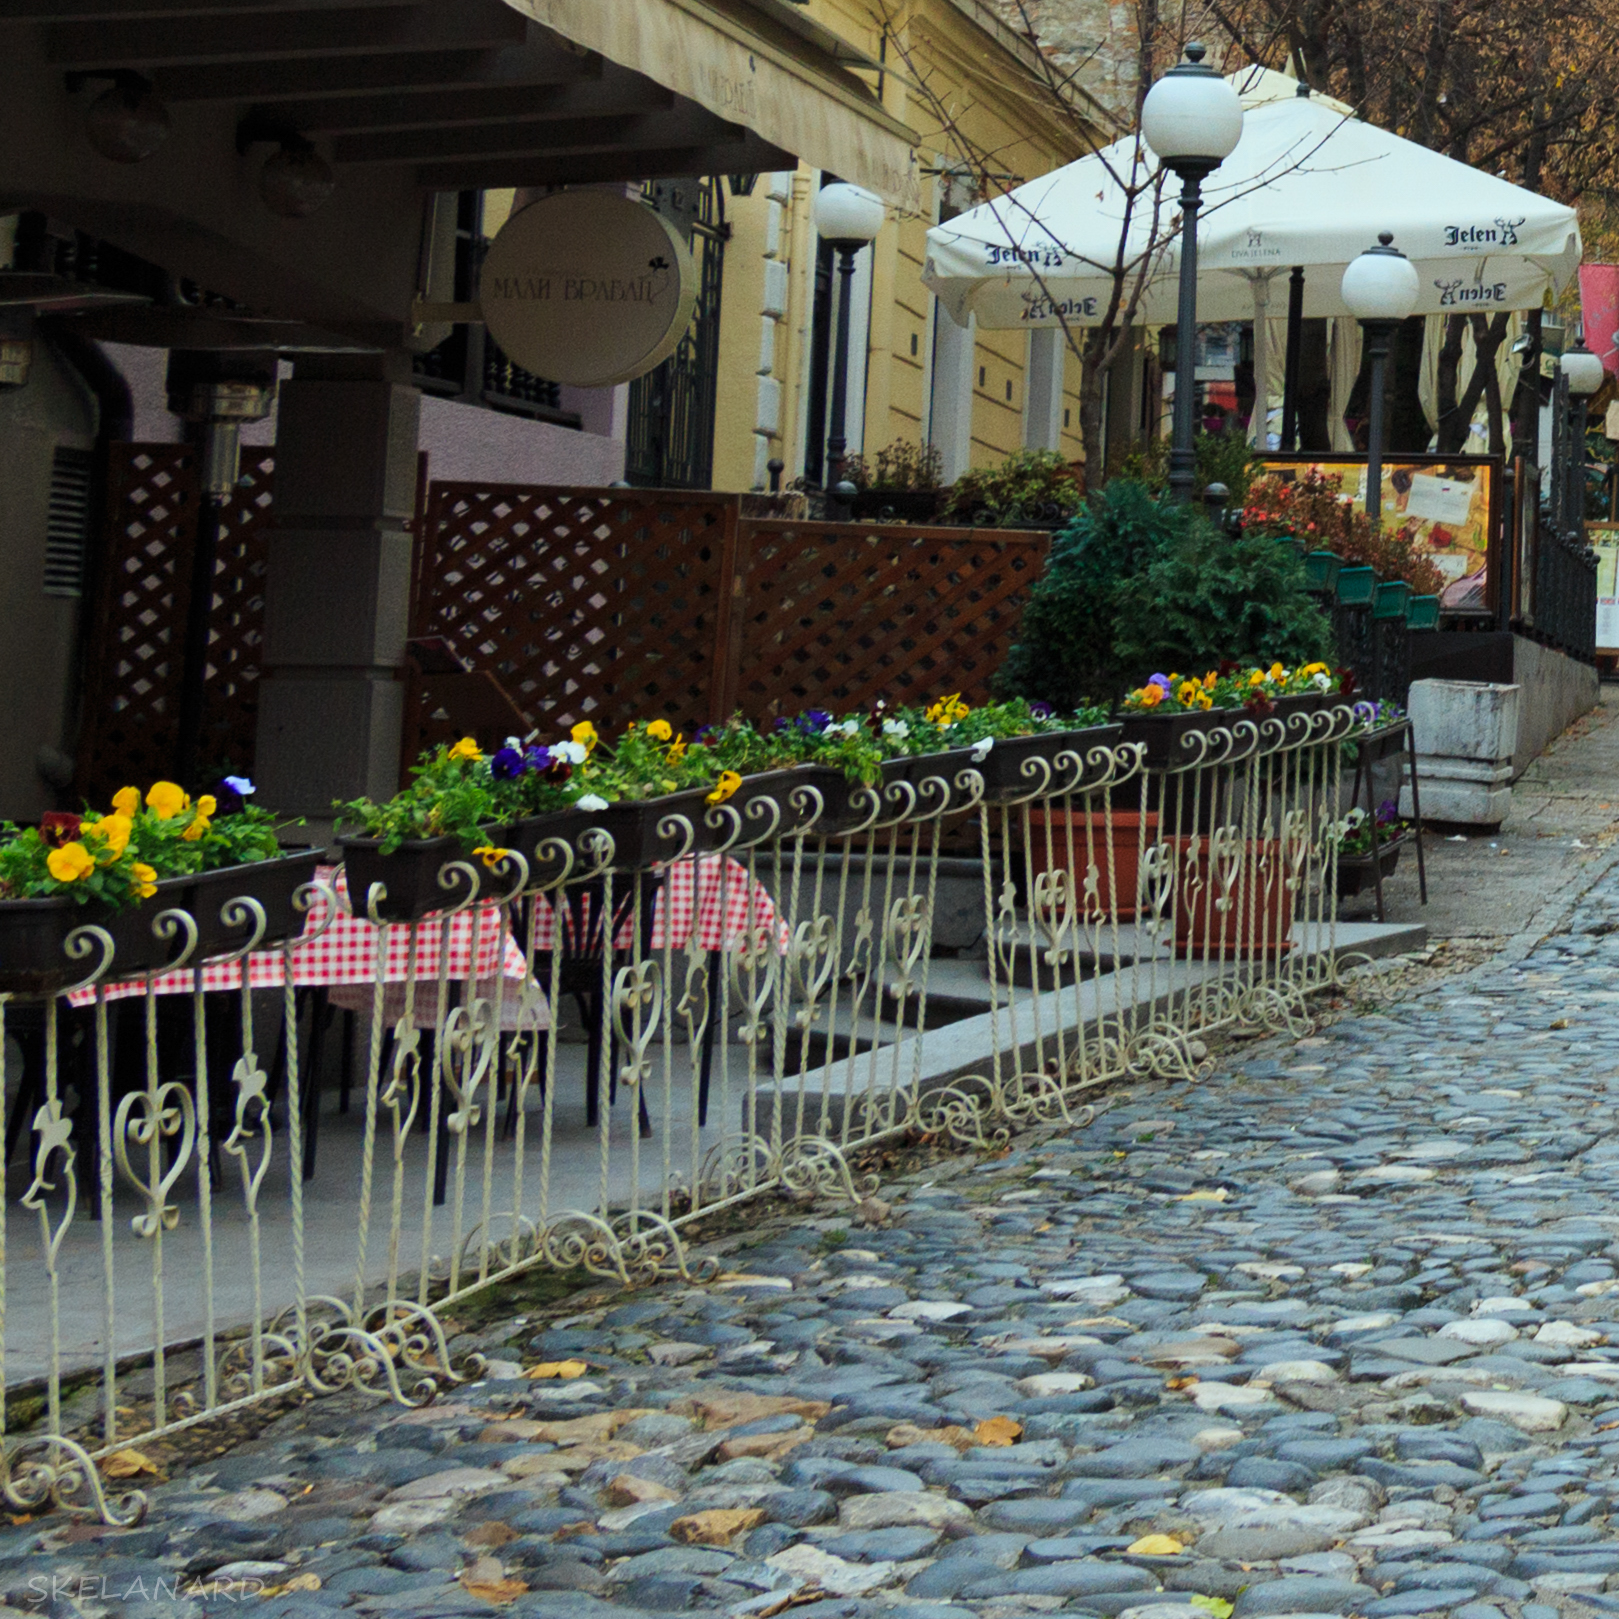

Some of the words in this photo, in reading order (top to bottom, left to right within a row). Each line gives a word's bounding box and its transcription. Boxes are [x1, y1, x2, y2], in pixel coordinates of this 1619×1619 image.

[1443, 225, 1497, 246] Jelen
[493, 278, 551, 300] МАЛИ
[564, 279, 655, 305] ВРАБАЦ
